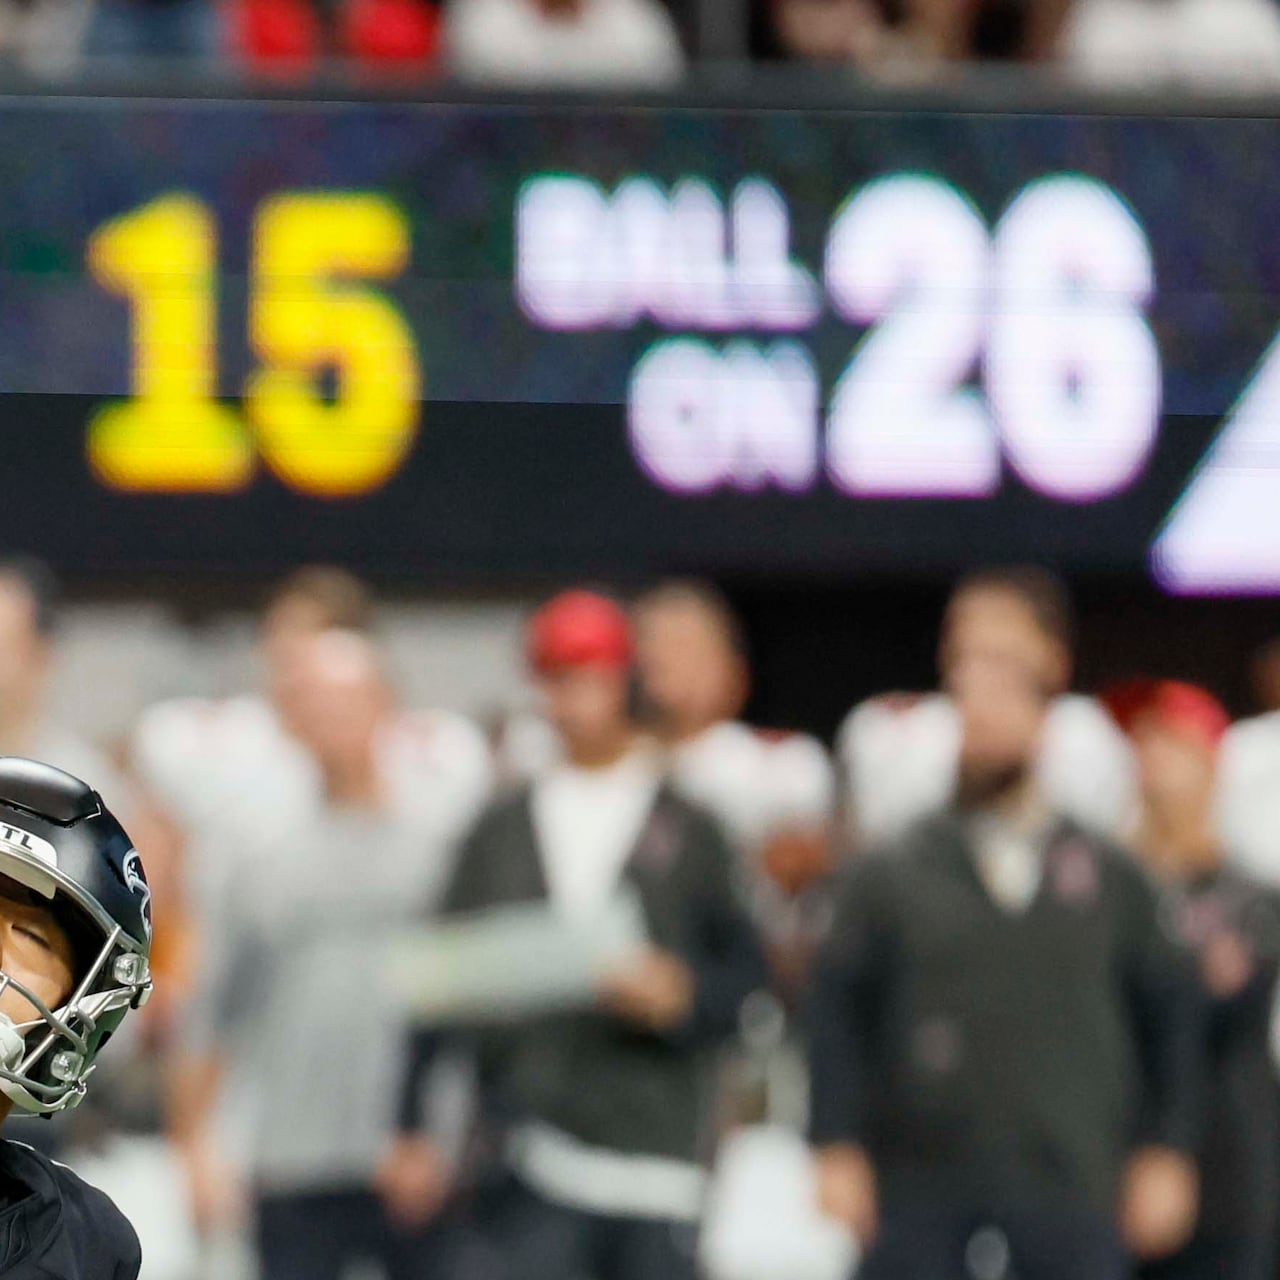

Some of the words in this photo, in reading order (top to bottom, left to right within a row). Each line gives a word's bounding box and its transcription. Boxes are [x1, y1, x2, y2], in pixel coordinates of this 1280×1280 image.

[84, 190, 423, 498] 15
[513, 172, 824, 332] BALL
[822, 172, 1164, 504] 26
[624, 336, 820, 494] ON
